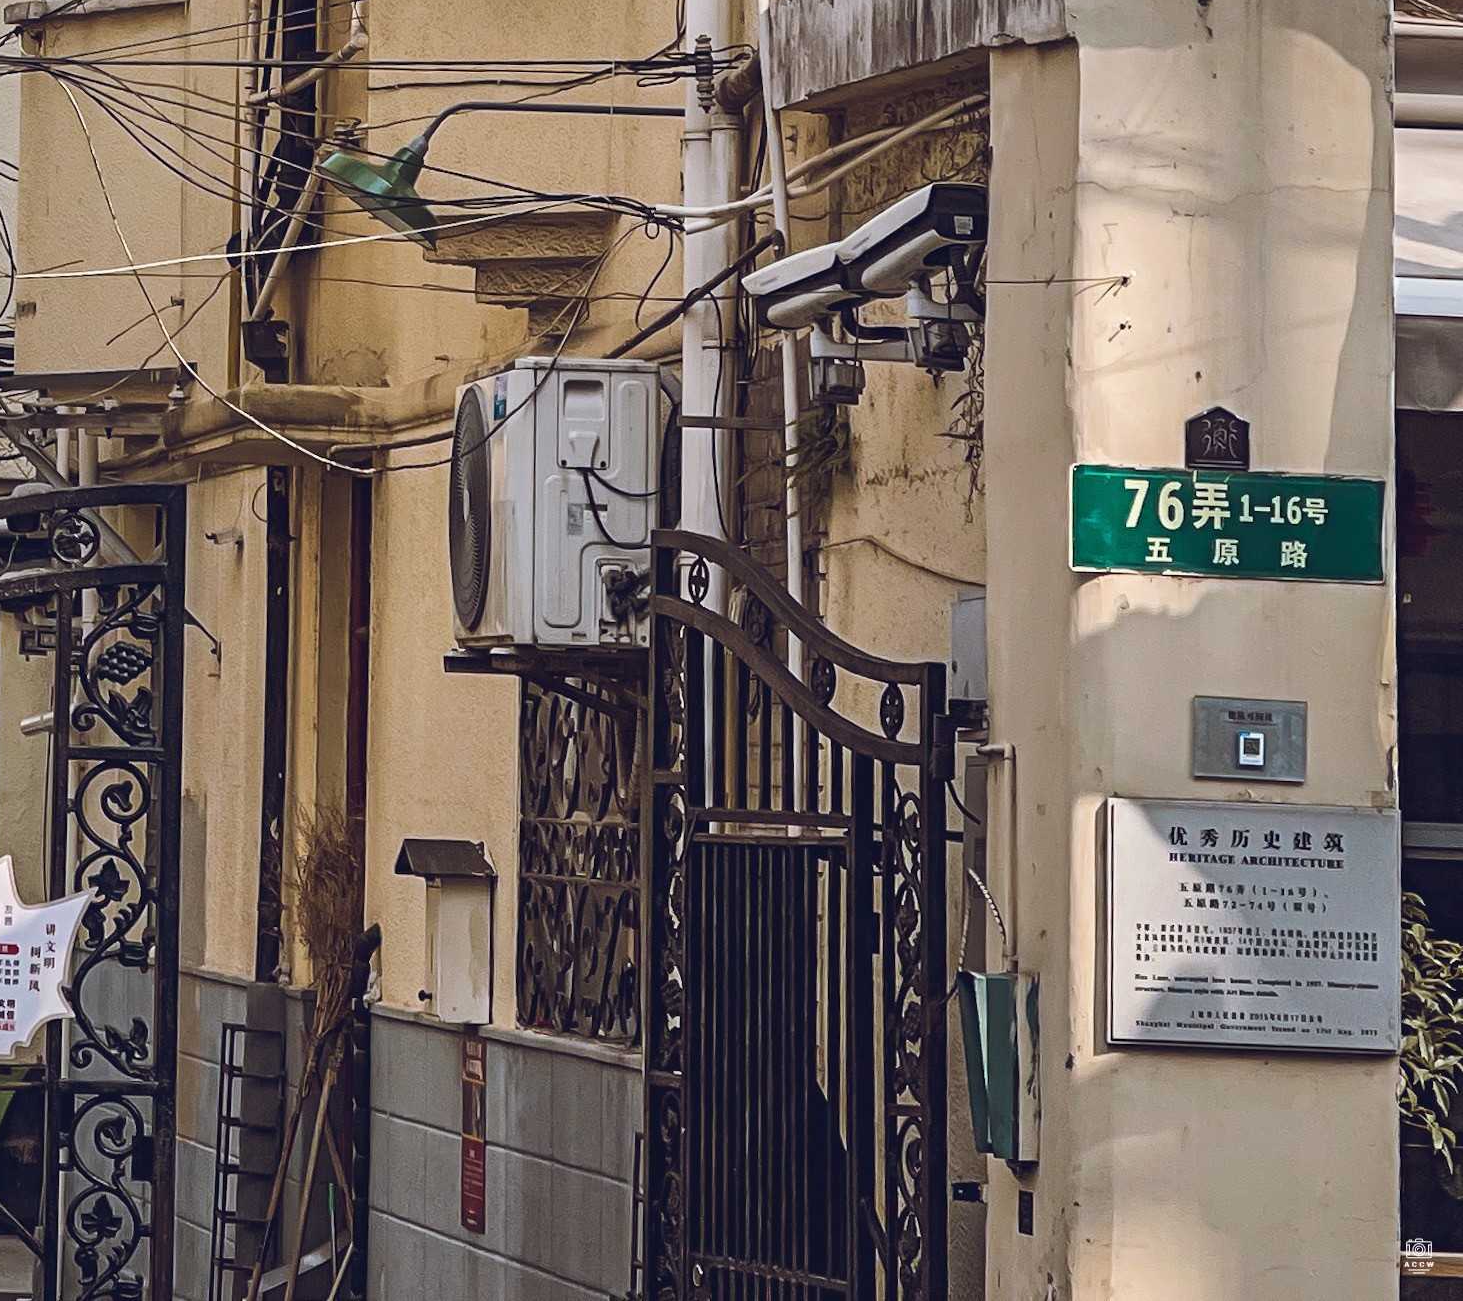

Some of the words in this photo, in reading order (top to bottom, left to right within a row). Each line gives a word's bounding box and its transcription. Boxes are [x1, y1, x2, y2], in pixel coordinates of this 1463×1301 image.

[1144, 536, 1309, 569] 五原路
[1169, 826, 1345, 854] 优秀历史建筑
[1168, 852, 1236, 865] HERITAGE
[1240, 856, 1345, 869] ARCHITECTURE
[43, 924, 56, 969] 讲文明
[29, 946, 41, 992] 树新风
